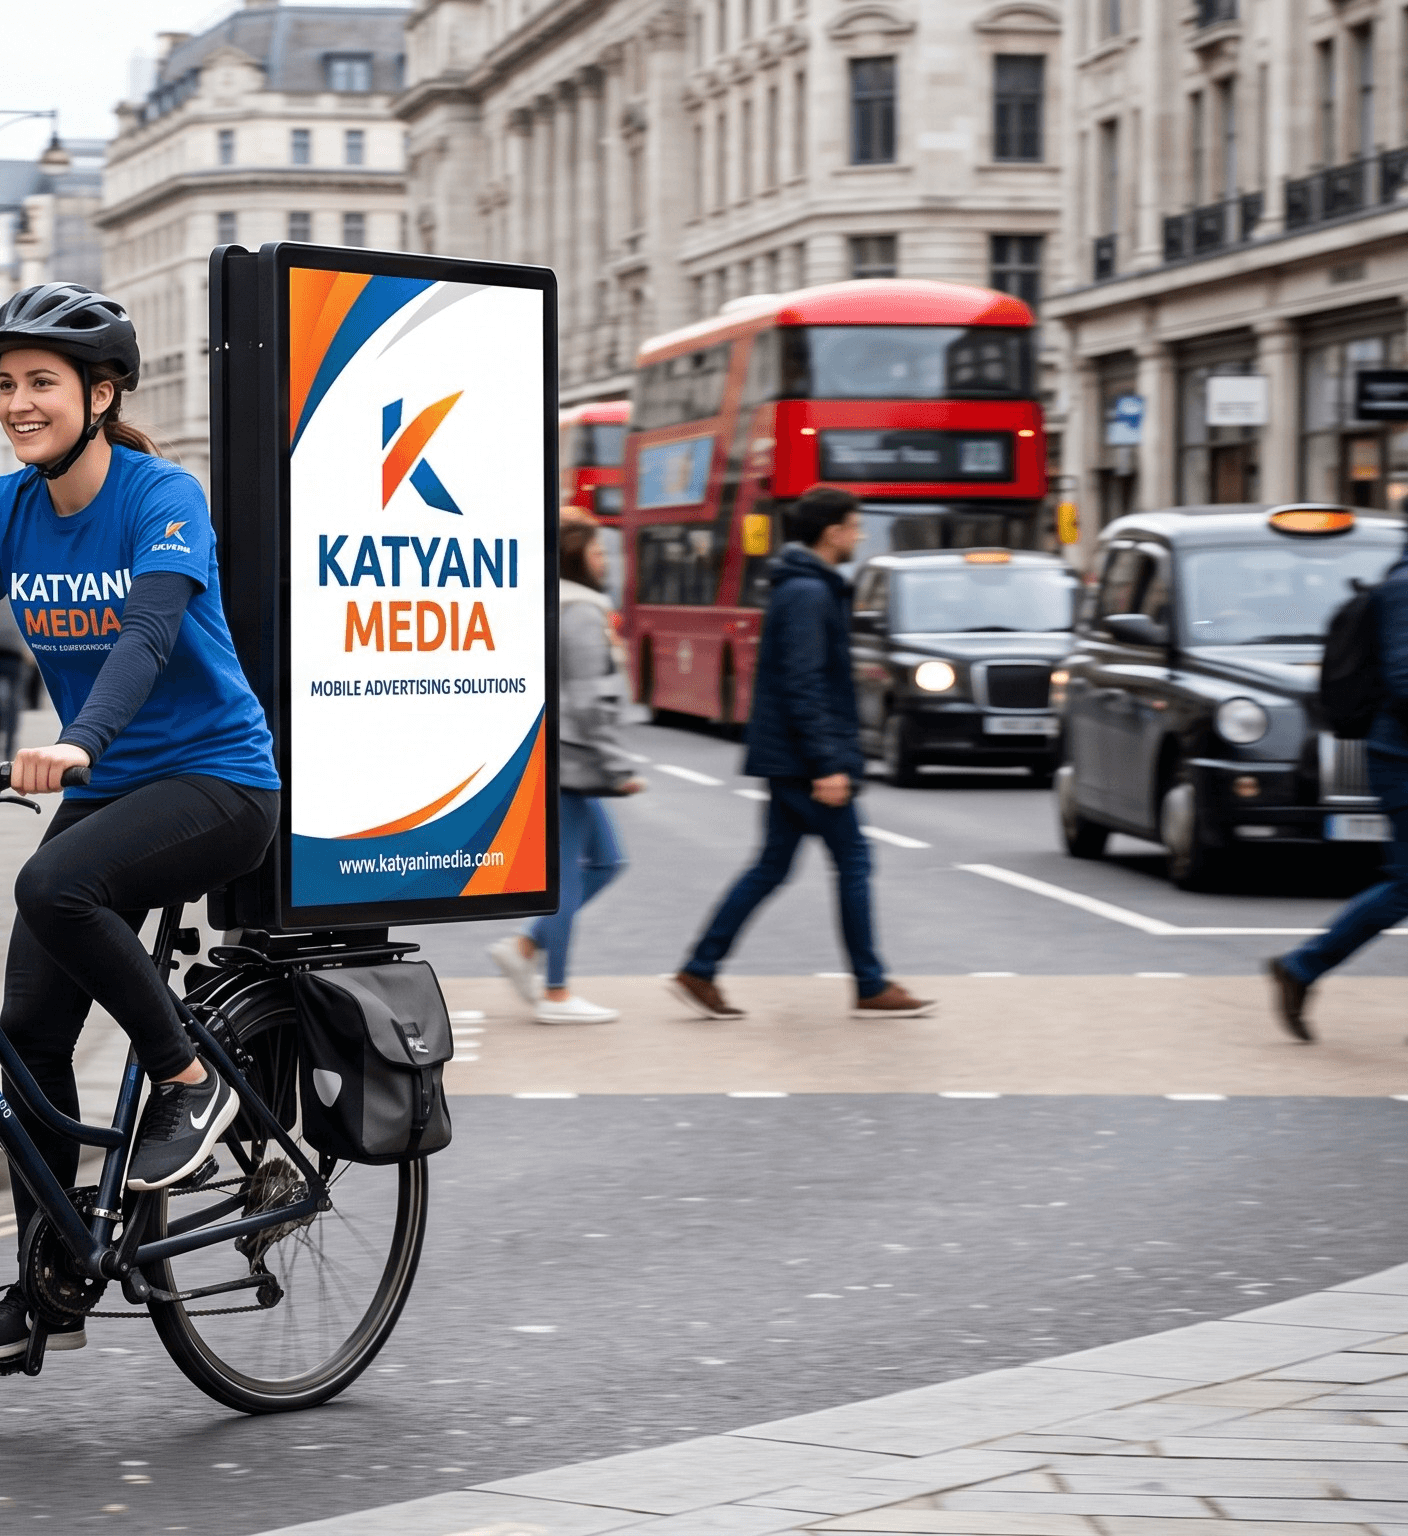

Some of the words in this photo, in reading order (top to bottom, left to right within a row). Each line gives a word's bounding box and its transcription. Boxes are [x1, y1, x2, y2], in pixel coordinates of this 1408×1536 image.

[318, 534, 518, 588] KATYANI
[24, 607, 122, 637] MEDIA
[344, 600, 496, 652] MEDIA
[310, 680, 362, 697] MOBILE
[364, 679, 451, 696] ADVERTISING
[453, 677, 527, 694] SOLUTIONS
[339, 849, 505, 877] www.katyanimedia.com
